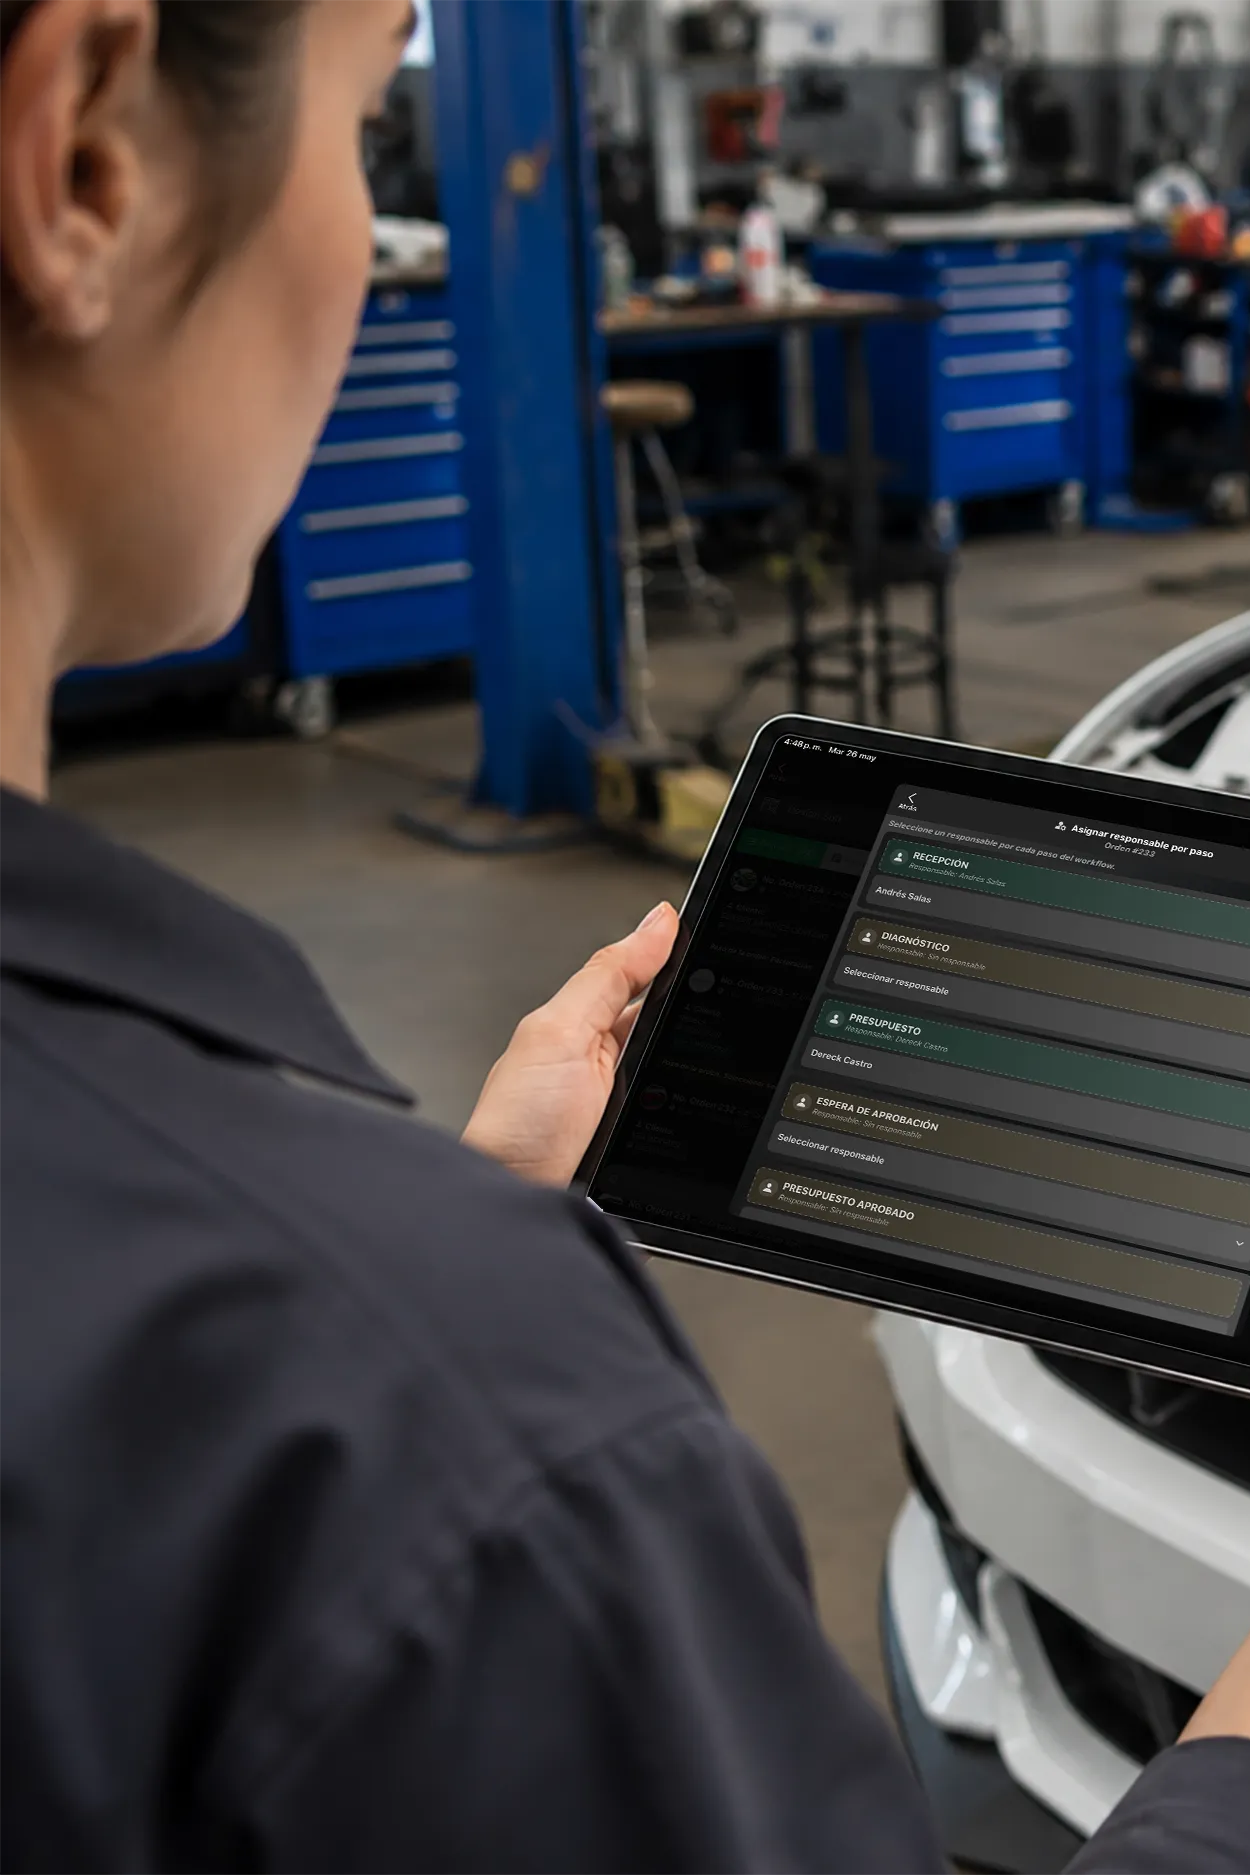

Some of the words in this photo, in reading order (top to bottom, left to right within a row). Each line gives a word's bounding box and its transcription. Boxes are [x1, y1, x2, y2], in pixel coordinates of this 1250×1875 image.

[828, 746, 845, 756] Mar
[846, 750, 858, 758] 26
[858, 754, 877, 763] may
[888, 820, 934, 835] Seleccione
[946, 831, 998, 847] responsable
[998, 841, 1014, 850] por
[1015, 843, 1036, 855] cada
[1036, 848, 1058, 859] paso
[1059, 851, 1074, 862] del
[1074, 856, 1116, 870] workflow.
[1071, 824, 1109, 838] Asignar
[1109, 832, 1170, 850] responsable
[1170, 842, 1188, 853] por
[1189, 846, 1214, 859] paso
[1104, 842, 1131, 853] Orden
[912, 851, 970, 869] RECEPCIÓN
[908, 862, 958, 877] Responsable:
[958, 872, 985, 883] Andrés
[986, 877, 1007, 887] Salas
[875, 886, 906, 899] Andrés
[907, 892, 932, 904] Salas
[881, 931, 950, 953] DIAGNÓSTICO
[877, 943, 926, 959] Responsable:
[927, 953, 940, 961] Sin
[940, 956, 987, 971] responsable
[843, 966, 895, 984] Seleccionar
[895, 978, 950, 996] responsable
[849, 1013, 922, 1036] PRESUPUESTO
[844, 1025, 894, 1041] Responsable:
[895, 1035, 923, 1047] Dereck
[923, 1041, 949, 1053] Castro
[810, 1048, 842, 1063] Dereck
[843, 1056, 873, 1069] Castro
[812, 1108, 862, 1126] Responsable:
[863, 1119, 876, 1128] Sin
[876, 1122, 923, 1139] responsable
[816, 1097, 854, 1113] ESPERA
[856, 1105, 871, 1116] DE
[871, 1109, 940, 1132] APROBACIÓN
[777, 1133, 829, 1152] Seleccionar
[830, 1145, 885, 1165] responsable
[778, 1193, 829, 1212] Responsable:
[829, 1206, 842, 1215] Sin
[842, 1209, 890, 1226] responsable
[782, 1182, 856, 1207] PRESUPUESTO
[856, 1200, 915, 1221] APROBADO
